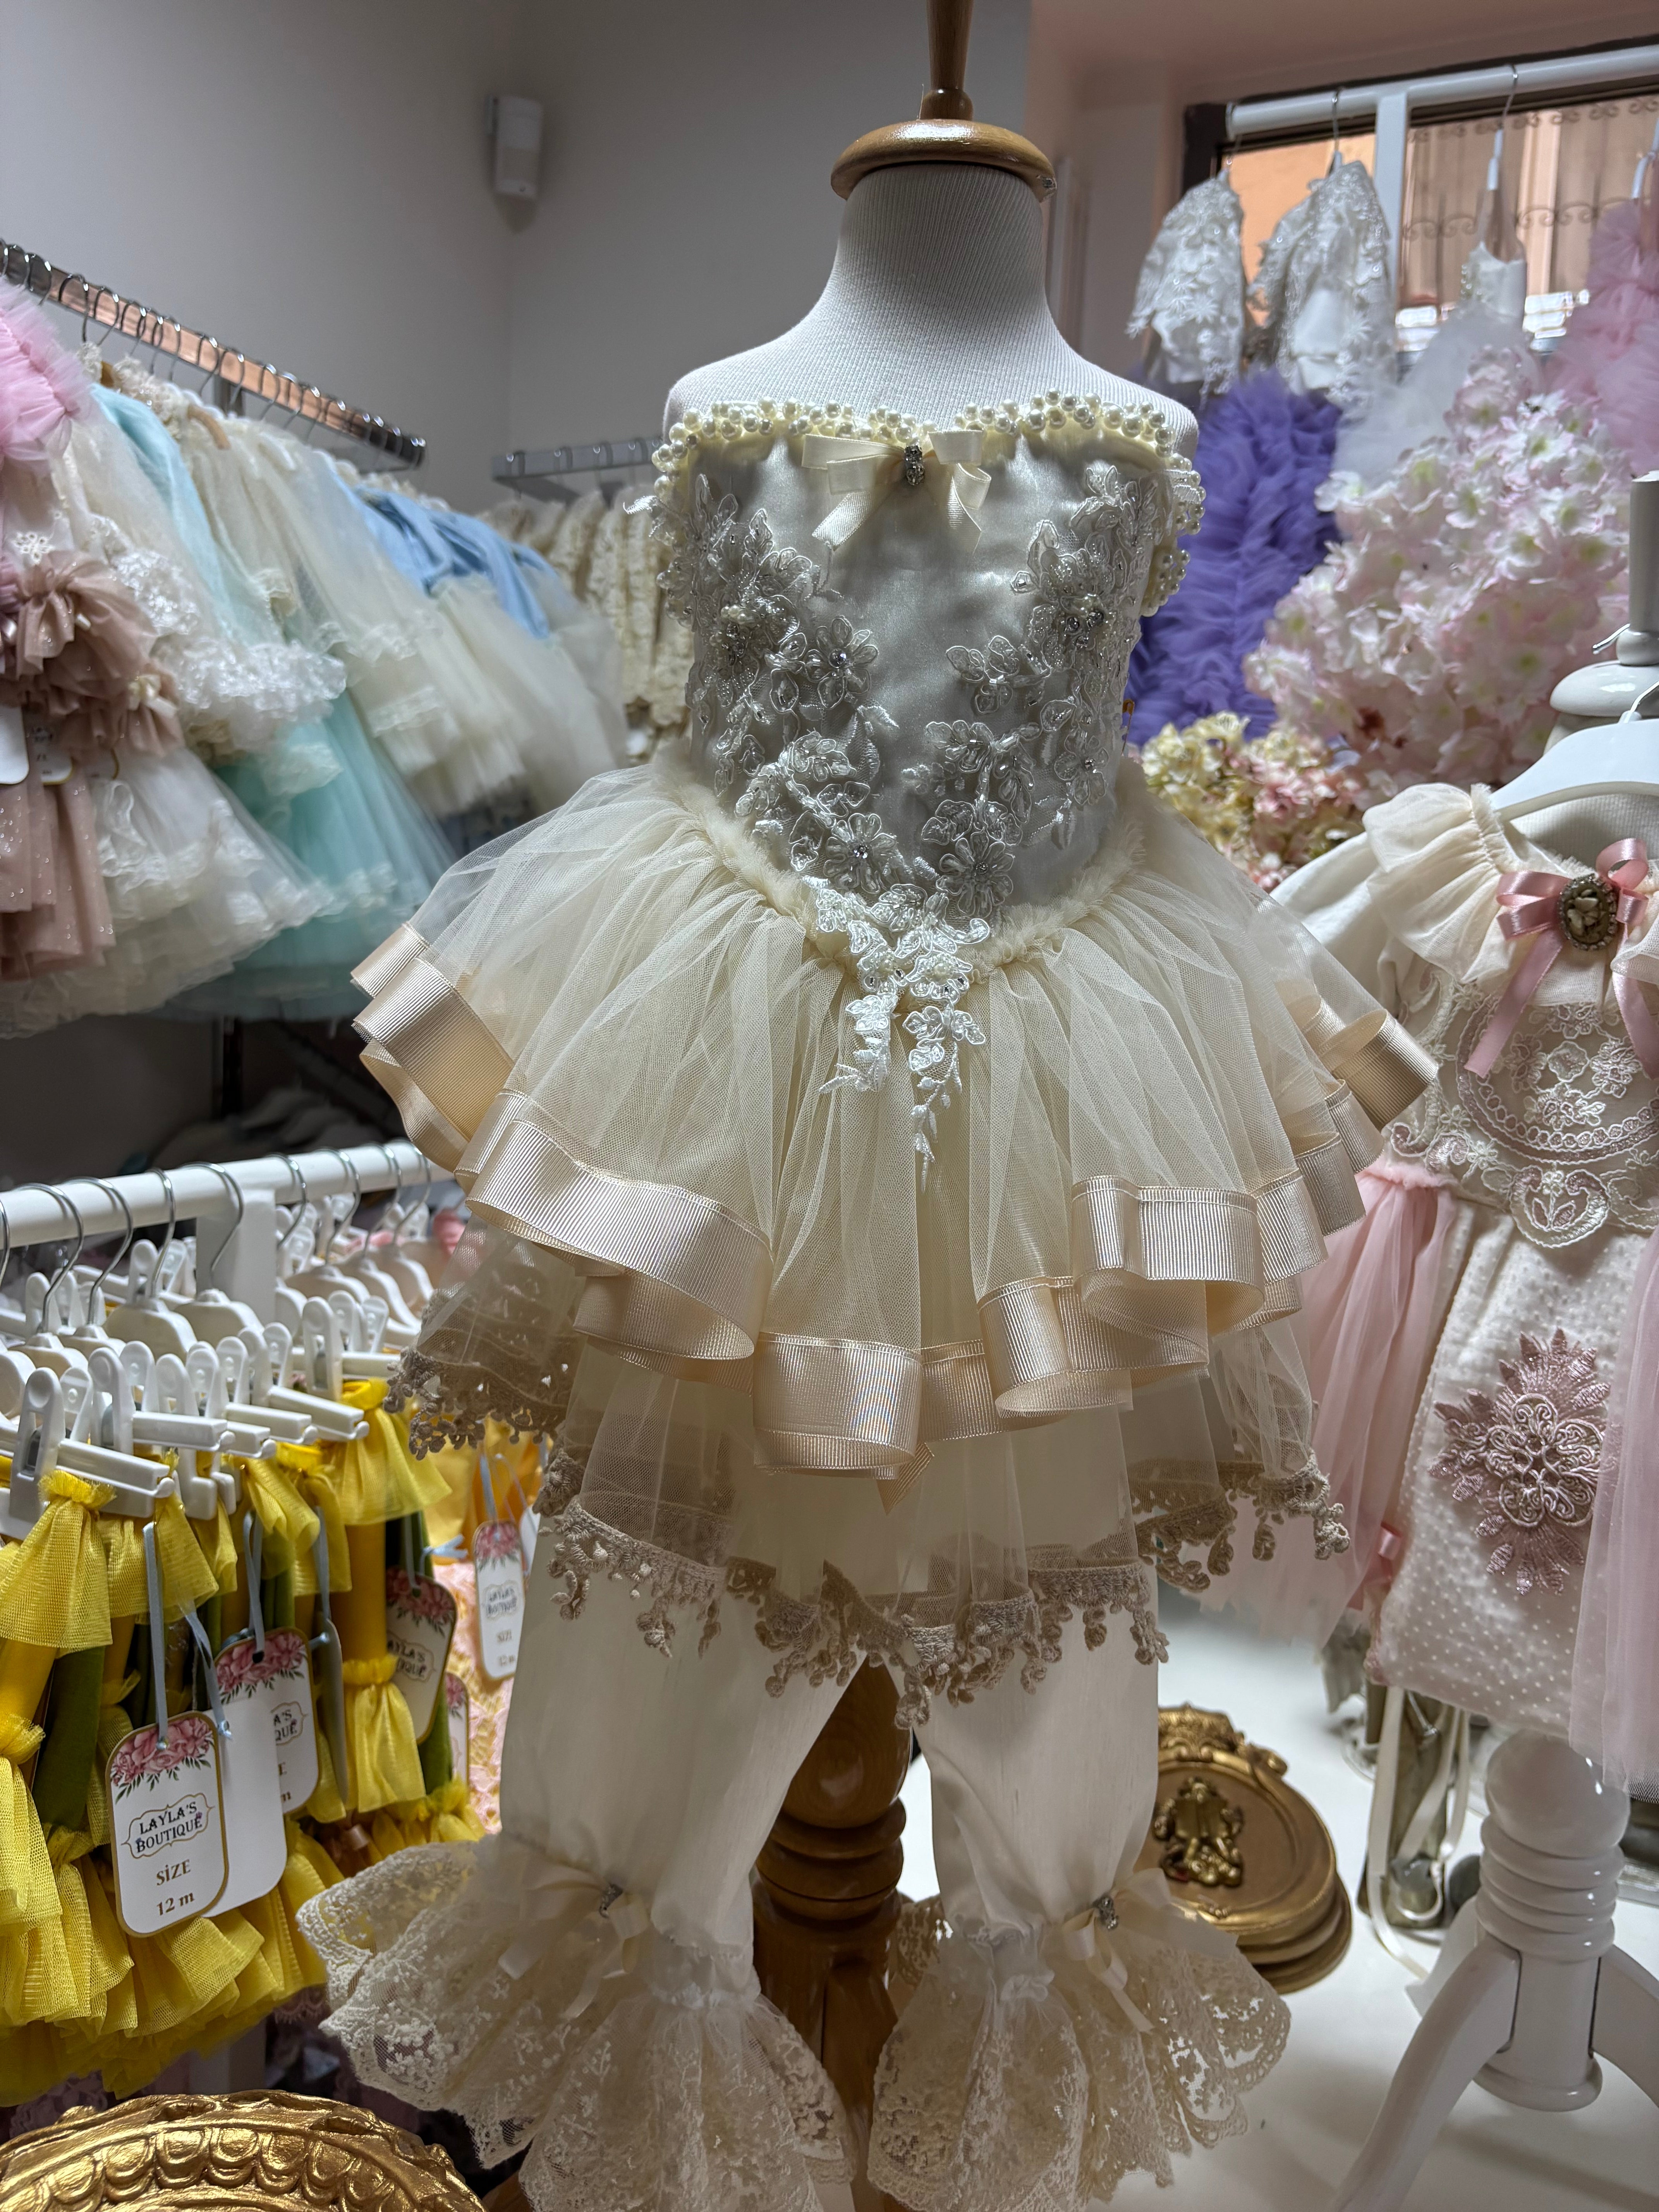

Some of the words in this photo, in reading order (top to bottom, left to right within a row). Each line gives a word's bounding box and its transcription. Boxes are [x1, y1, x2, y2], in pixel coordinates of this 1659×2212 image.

[140, 1802, 197, 1835] LAYLA'S
[137, 1818, 202, 1853] BOUTIQUE
[156, 1898, 175, 1916] 12
[179, 1892, 194, 1907] m
